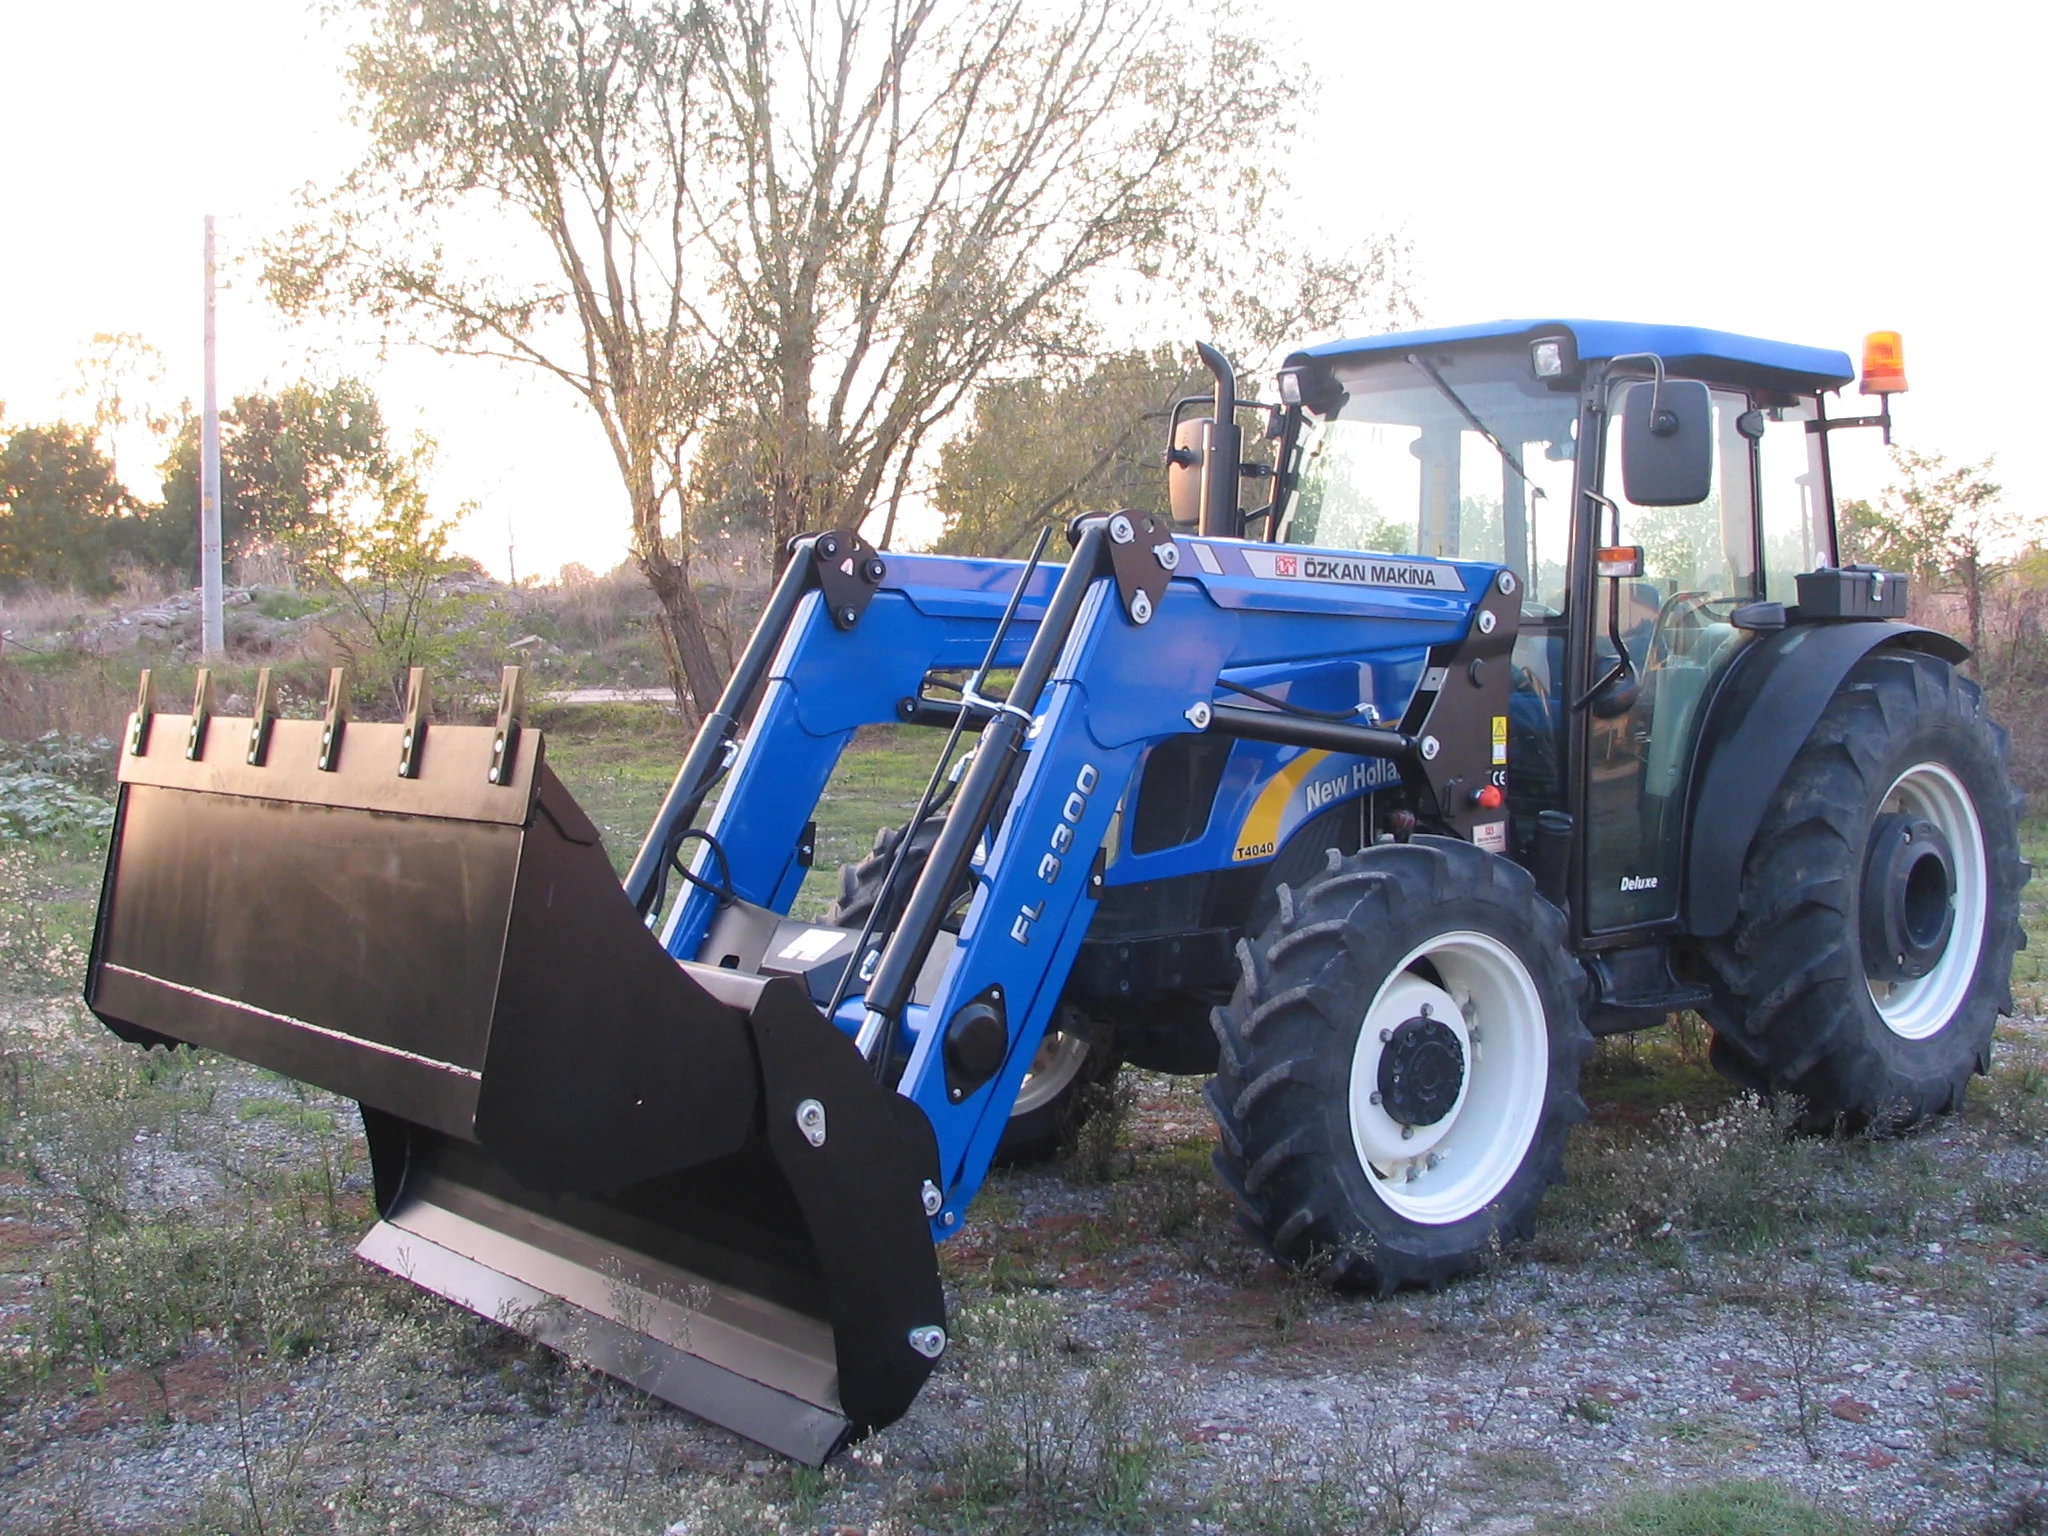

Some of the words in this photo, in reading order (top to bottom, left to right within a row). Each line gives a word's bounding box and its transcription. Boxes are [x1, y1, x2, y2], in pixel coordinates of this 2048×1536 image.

[1304, 557, 1366, 581] ÖZKAN
[1305, 774, 1348, 812] New
[1353, 758, 1401, 790] Holla
[1492, 770, 1506, 786] CE
[1009, 899, 1046, 946] FL
[1037, 763, 1099, 885] 3300
[1236, 842, 1274, 859] T4040
[1620, 875, 1658, 892] Deluxe
